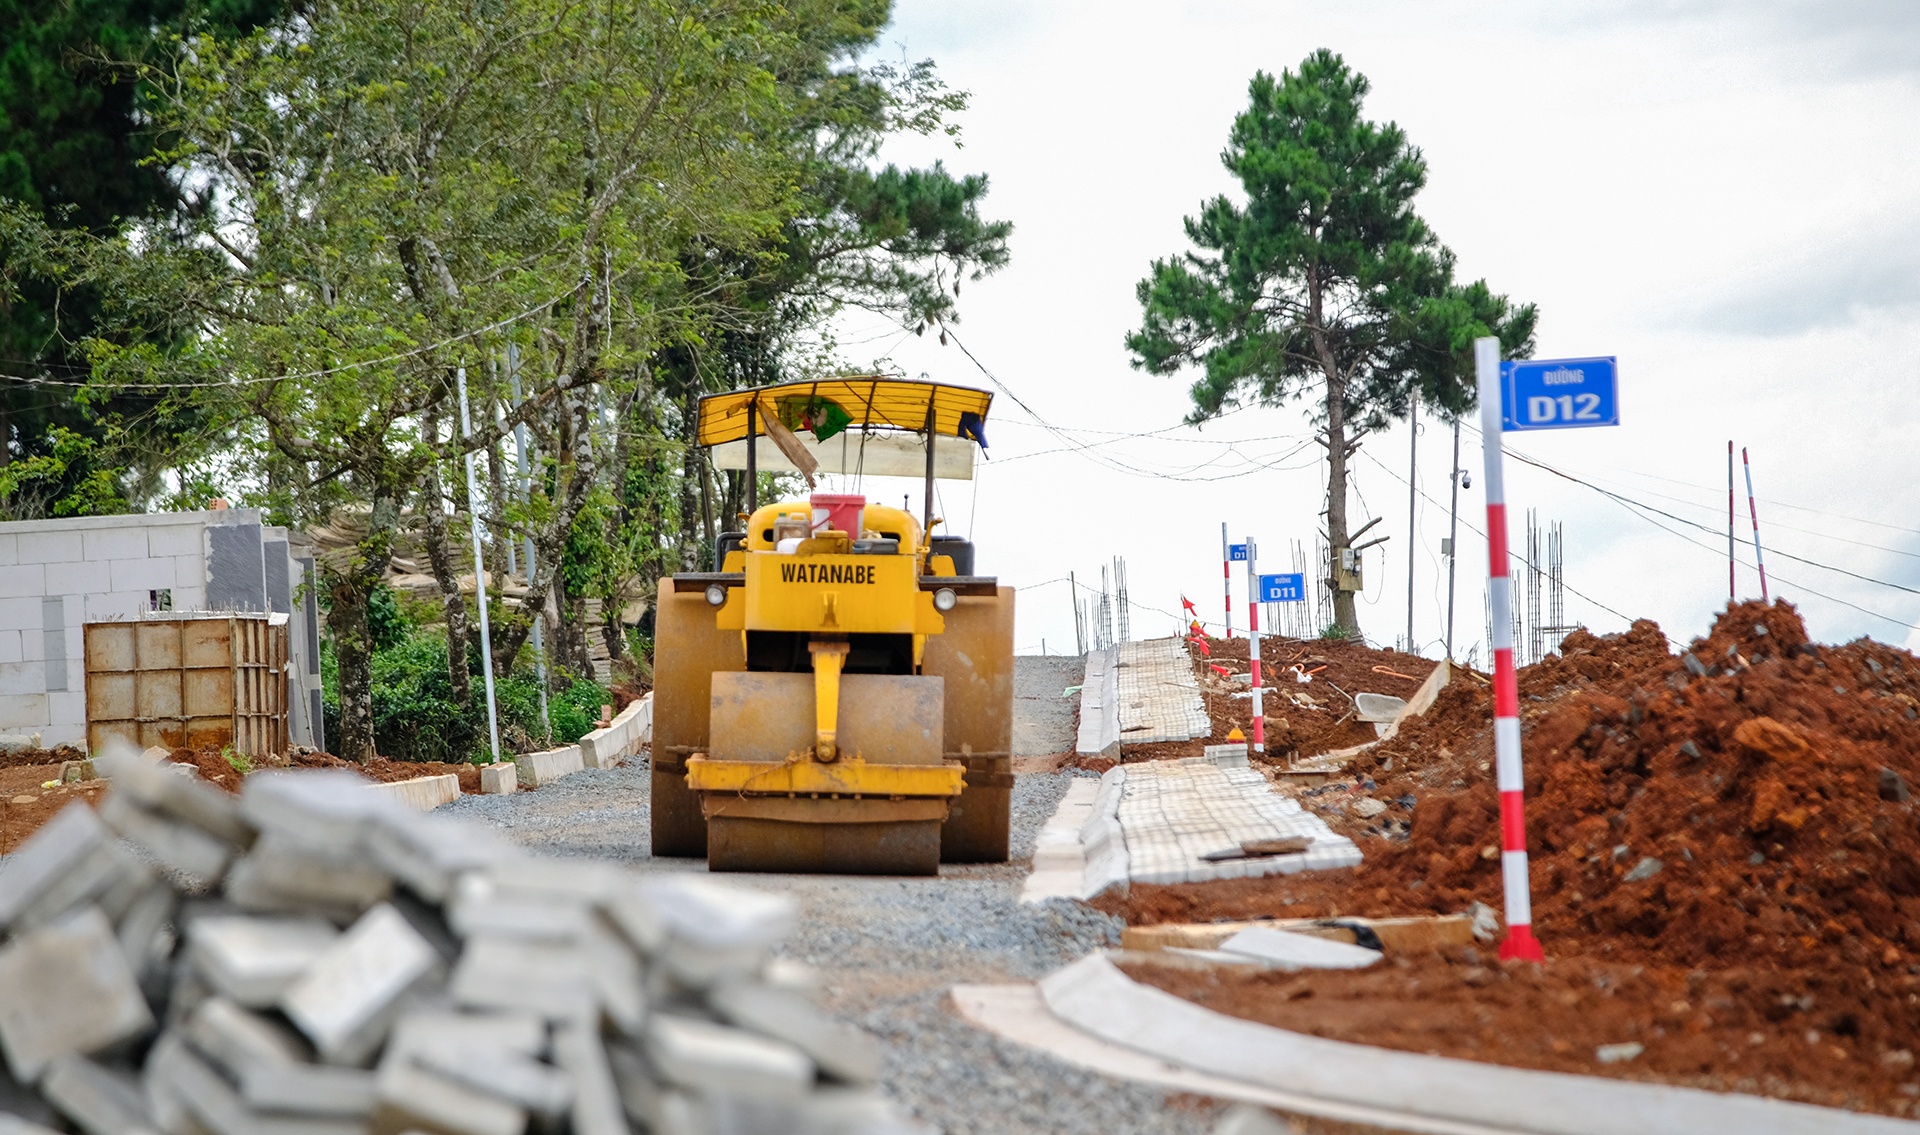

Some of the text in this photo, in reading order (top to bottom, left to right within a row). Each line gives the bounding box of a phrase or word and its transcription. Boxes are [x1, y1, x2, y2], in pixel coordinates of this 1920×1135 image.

[1528, 393, 1601, 423] D12
[781, 563, 876, 585] WATANABE
[1270, 587, 1296, 599] D11
